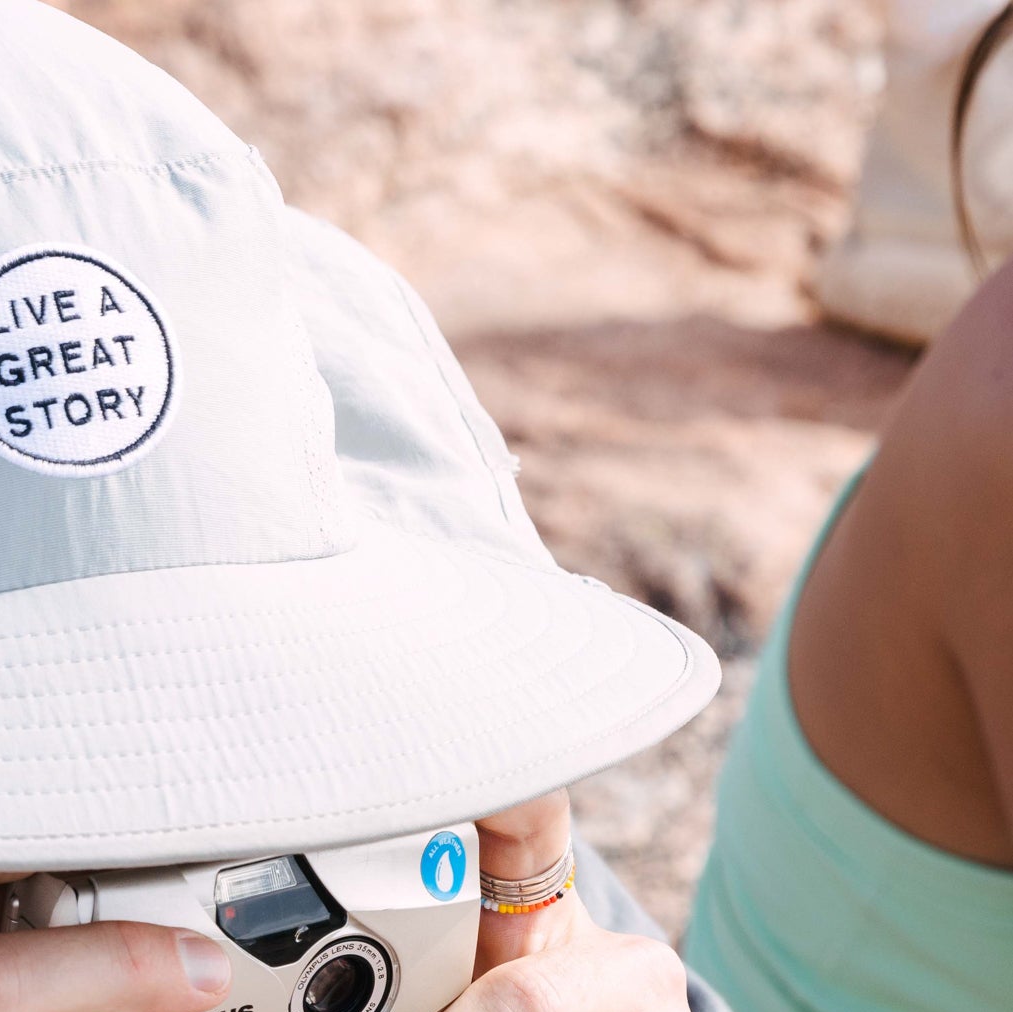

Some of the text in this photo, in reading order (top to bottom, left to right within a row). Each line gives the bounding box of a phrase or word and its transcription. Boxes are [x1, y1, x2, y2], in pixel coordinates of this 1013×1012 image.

[100, 285, 126, 317] A
[5, 386, 146, 438] STORY
[297, 952, 329, 991] OLYMPUS
[331, 943, 355, 955] LENS
[356, 943, 377, 960] 35mm
